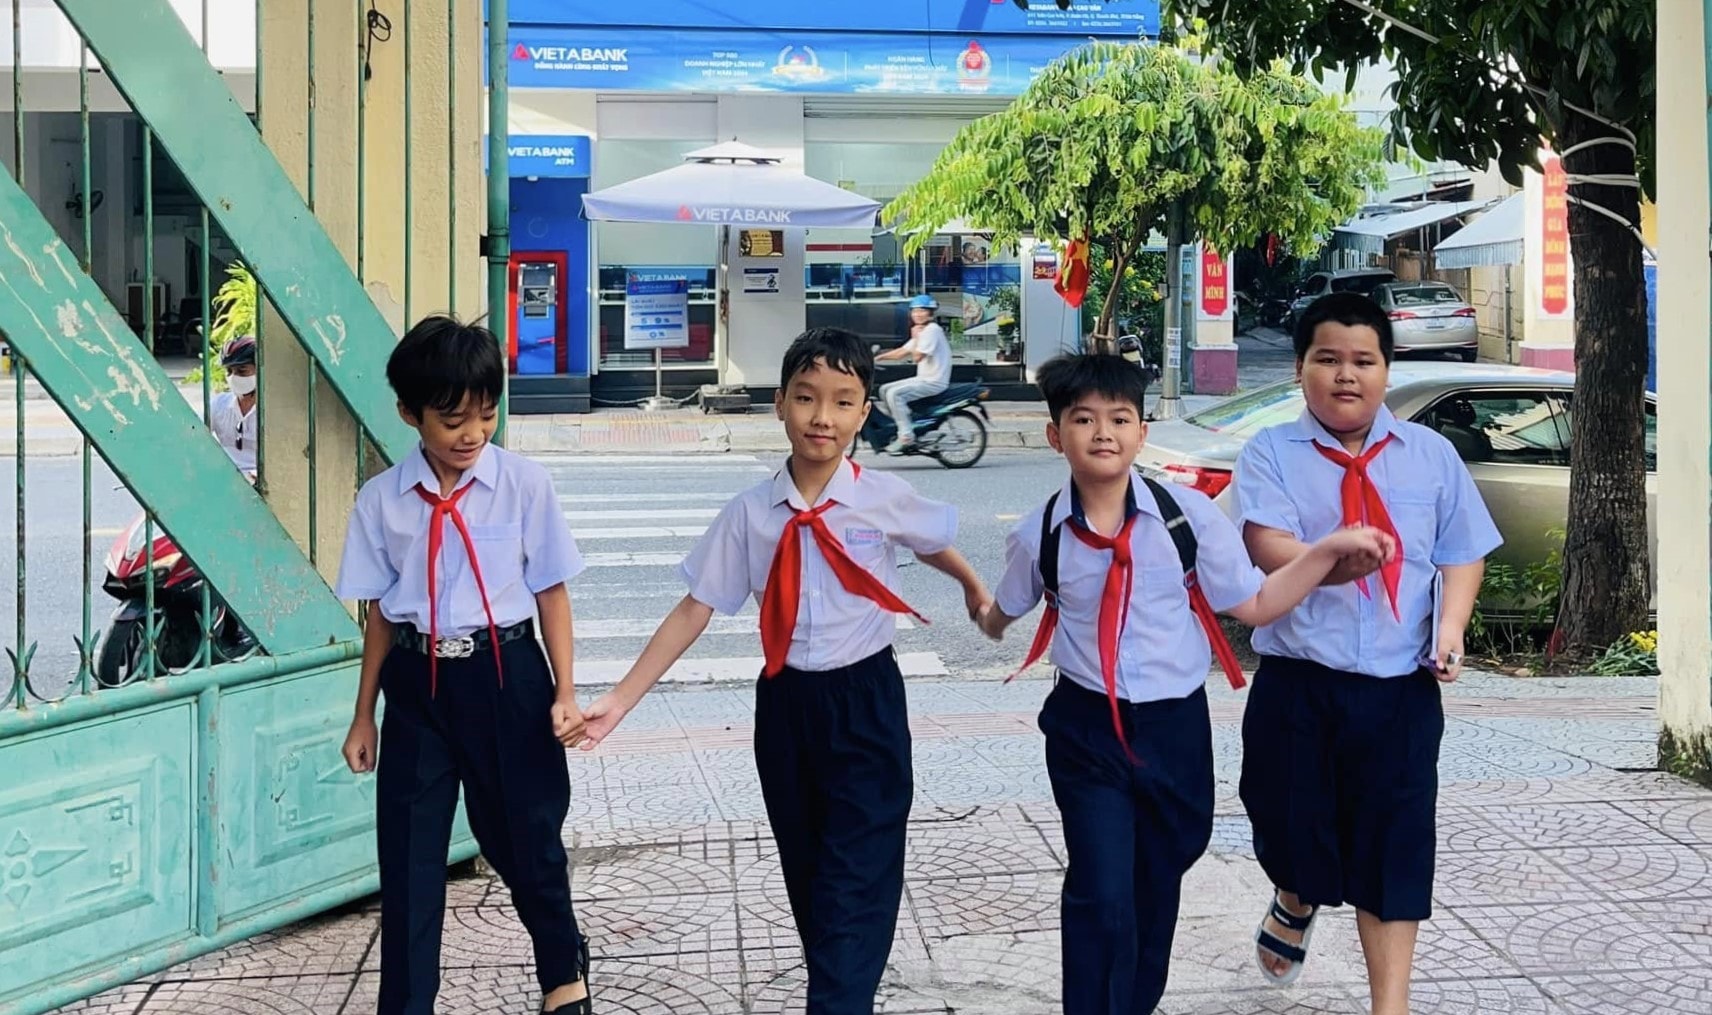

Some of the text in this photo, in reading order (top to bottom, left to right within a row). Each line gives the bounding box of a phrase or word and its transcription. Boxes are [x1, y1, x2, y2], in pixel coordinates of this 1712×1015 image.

[529, 47, 628, 62] VIETABANK
[508, 147, 574, 157] VIETABANK
[555, 158, 575, 166] ATM
[692, 207, 792, 223] VIETABANK
